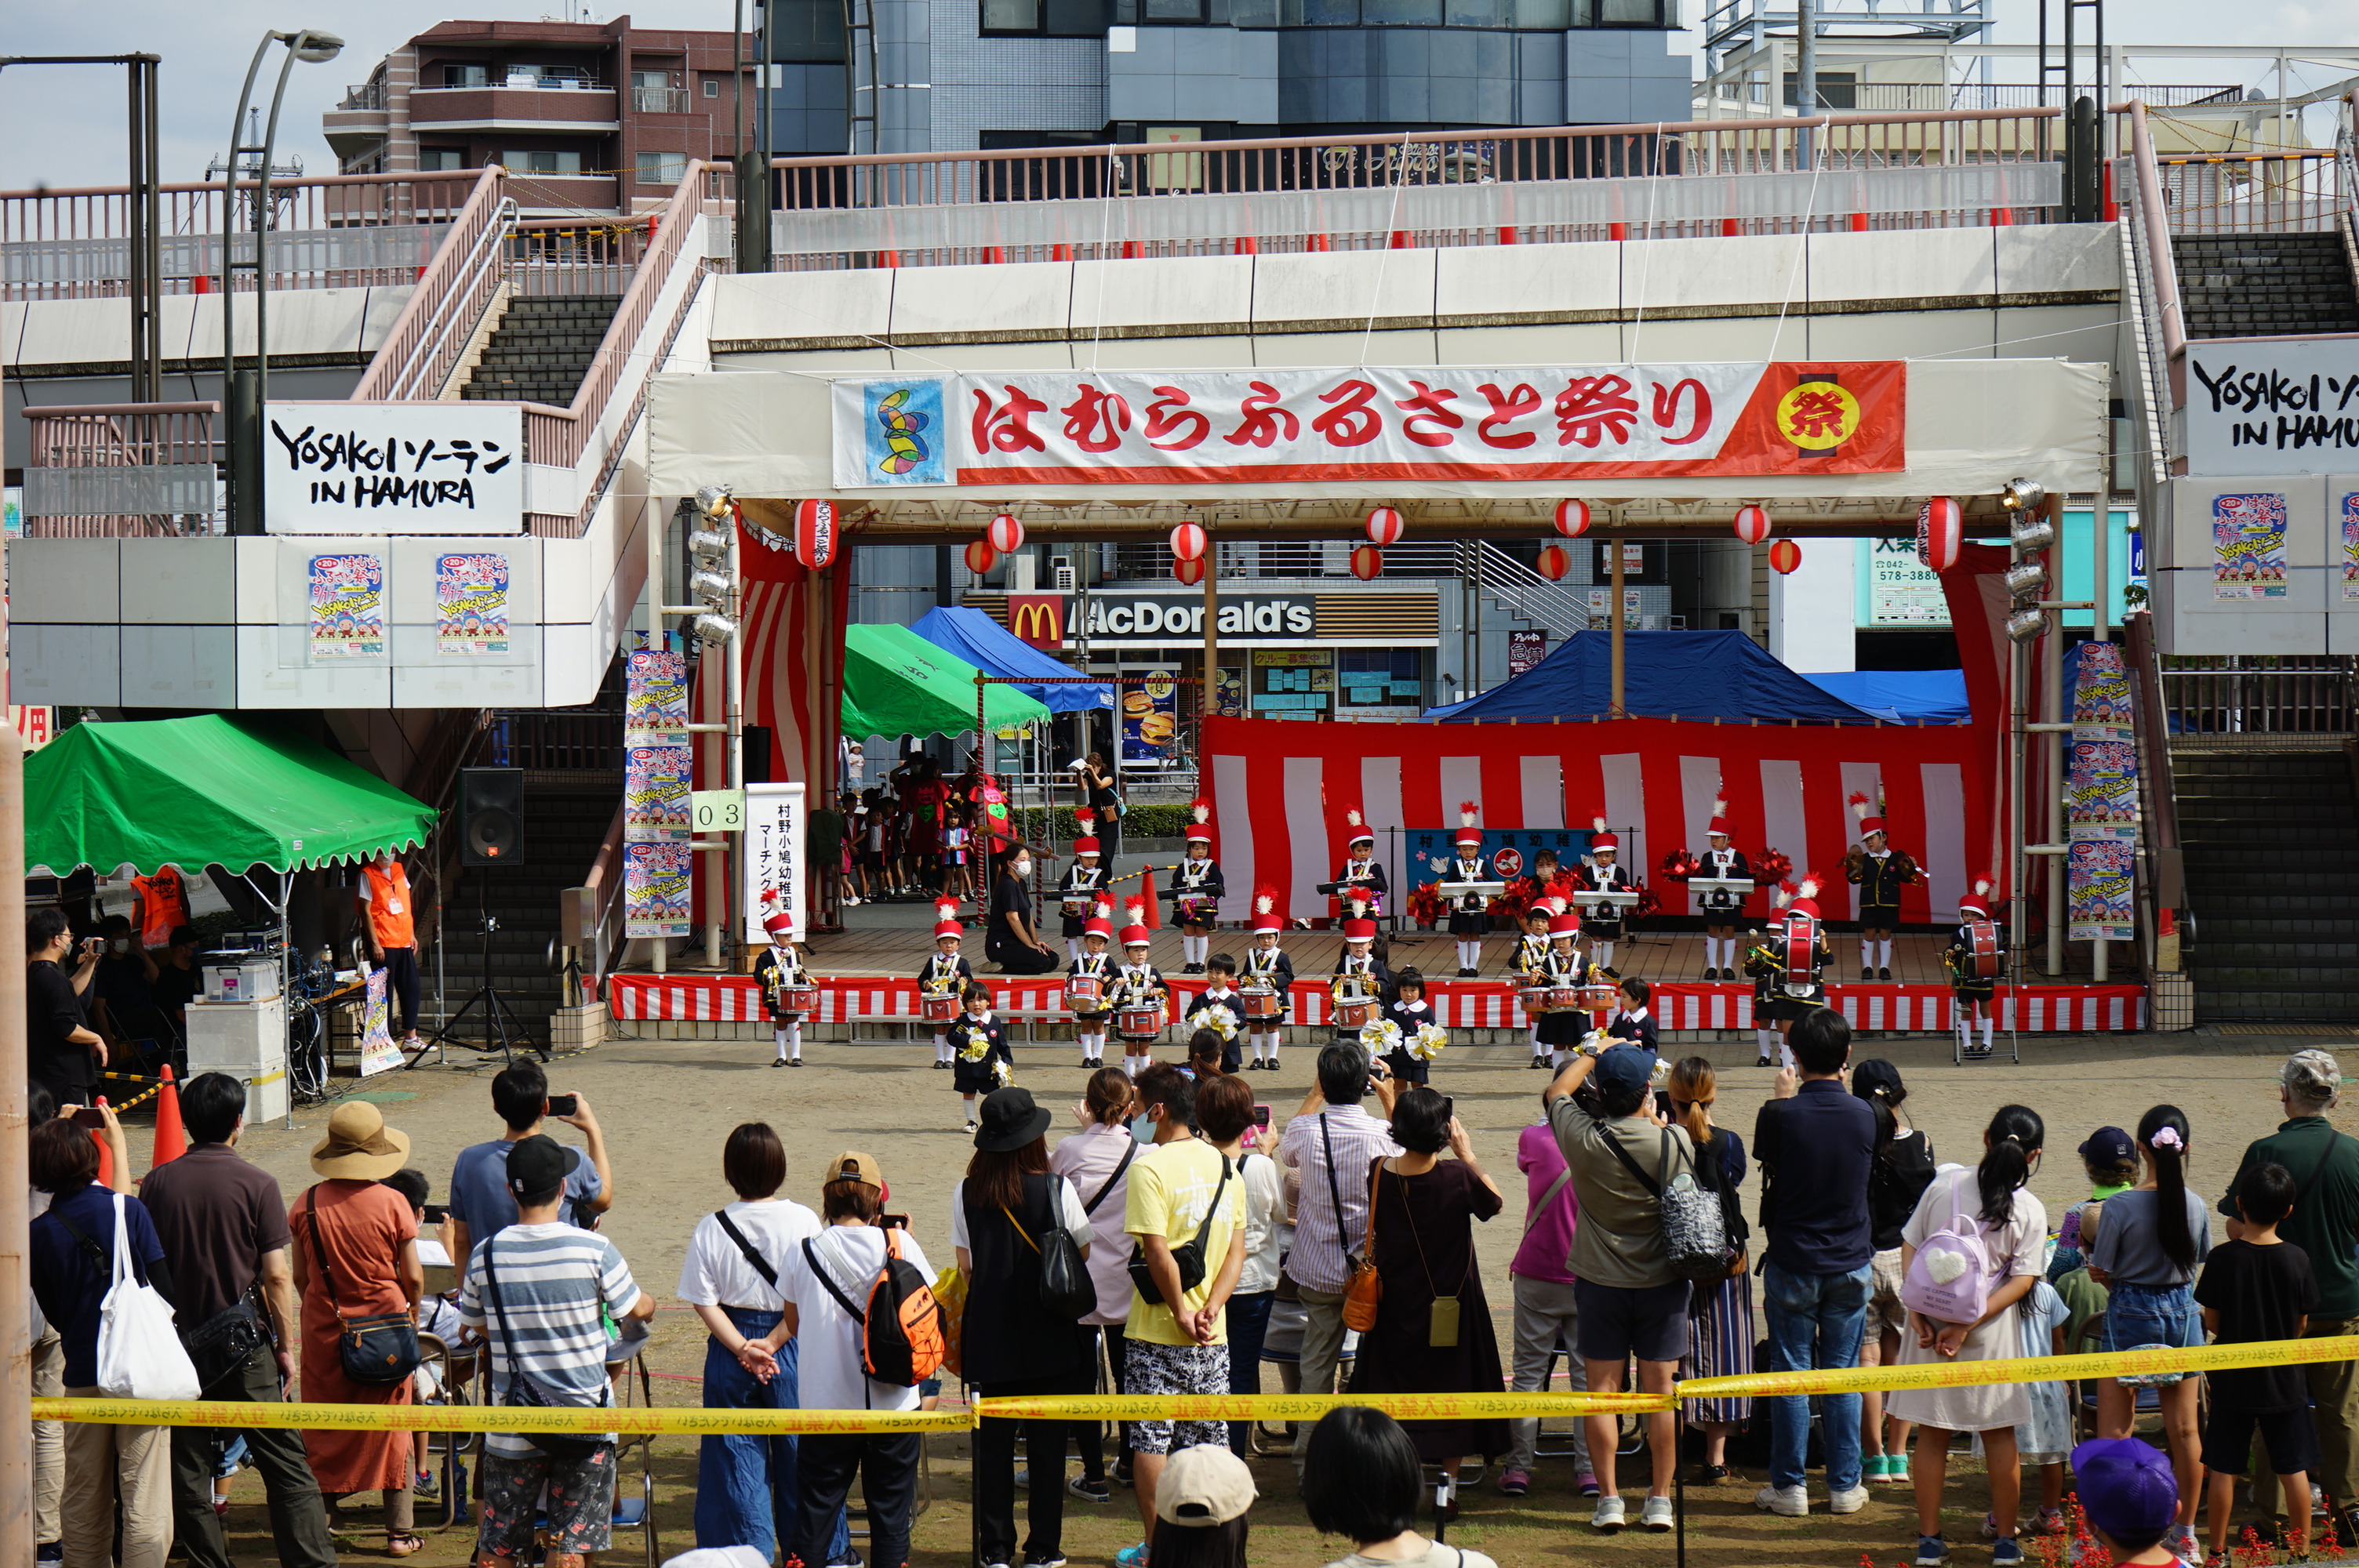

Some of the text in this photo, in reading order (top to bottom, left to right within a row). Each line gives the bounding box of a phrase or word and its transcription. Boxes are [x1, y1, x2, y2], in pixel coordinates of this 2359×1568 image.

[972, 373, 1713, 455] はむらふるさと祭り
[1790, 390, 1845, 438] 祭
[2233, 421, 2267, 447] IN
[311, 475, 474, 509] IN HAMURA
[1880, 571, 1939, 580] 578-3880
[1510, 643, 1543, 664] 急募
[759, 825, 772, 930] マーチングン
[778, 804, 792, 911] 村野小鳩幼稚園
